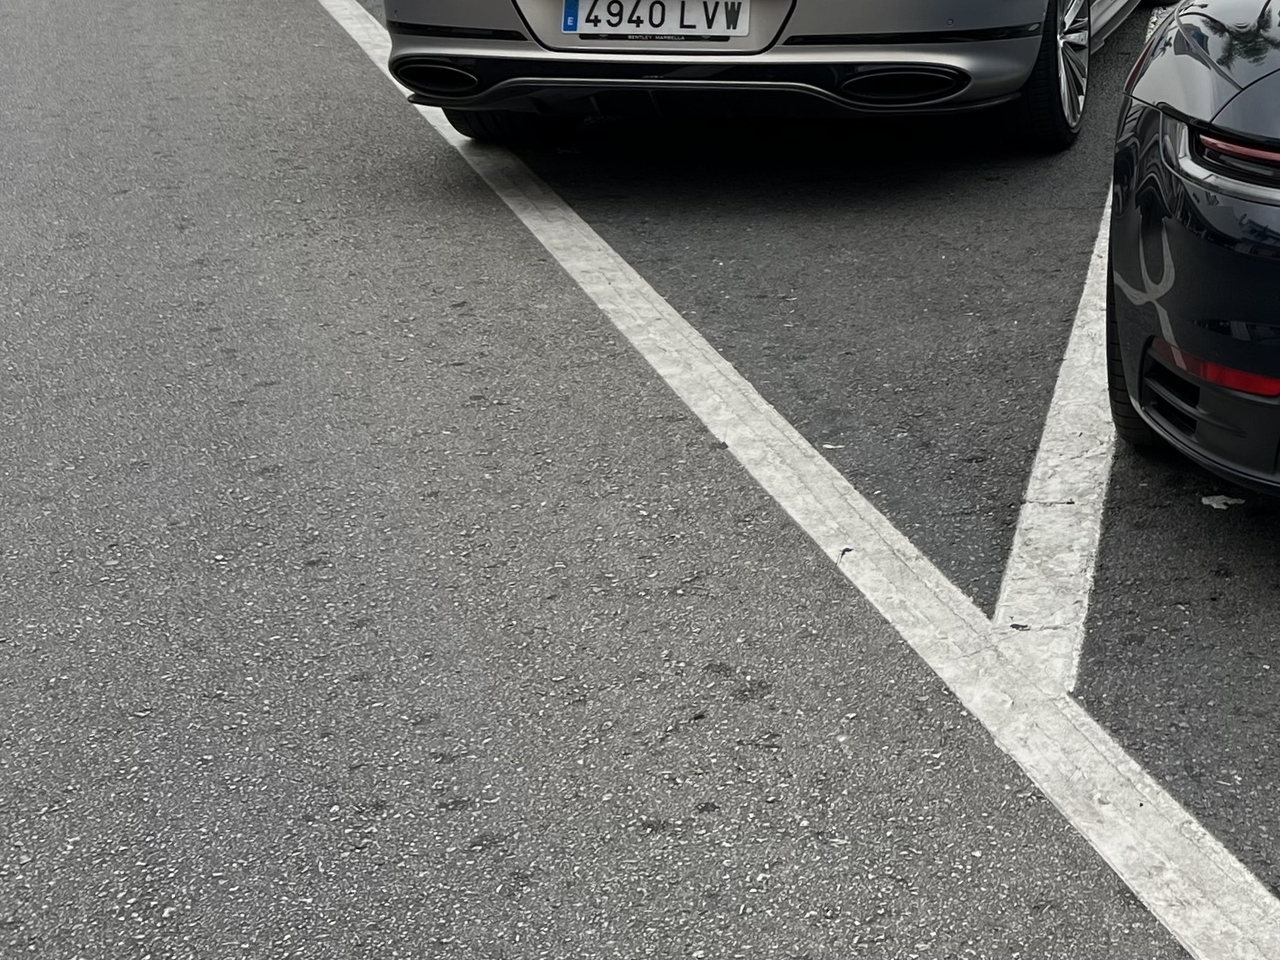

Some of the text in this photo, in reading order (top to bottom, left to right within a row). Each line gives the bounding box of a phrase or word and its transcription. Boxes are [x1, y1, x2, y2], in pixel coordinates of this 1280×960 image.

[567, 16, 574, 26] E
[585, 0, 742, 30] 4940 LVW
